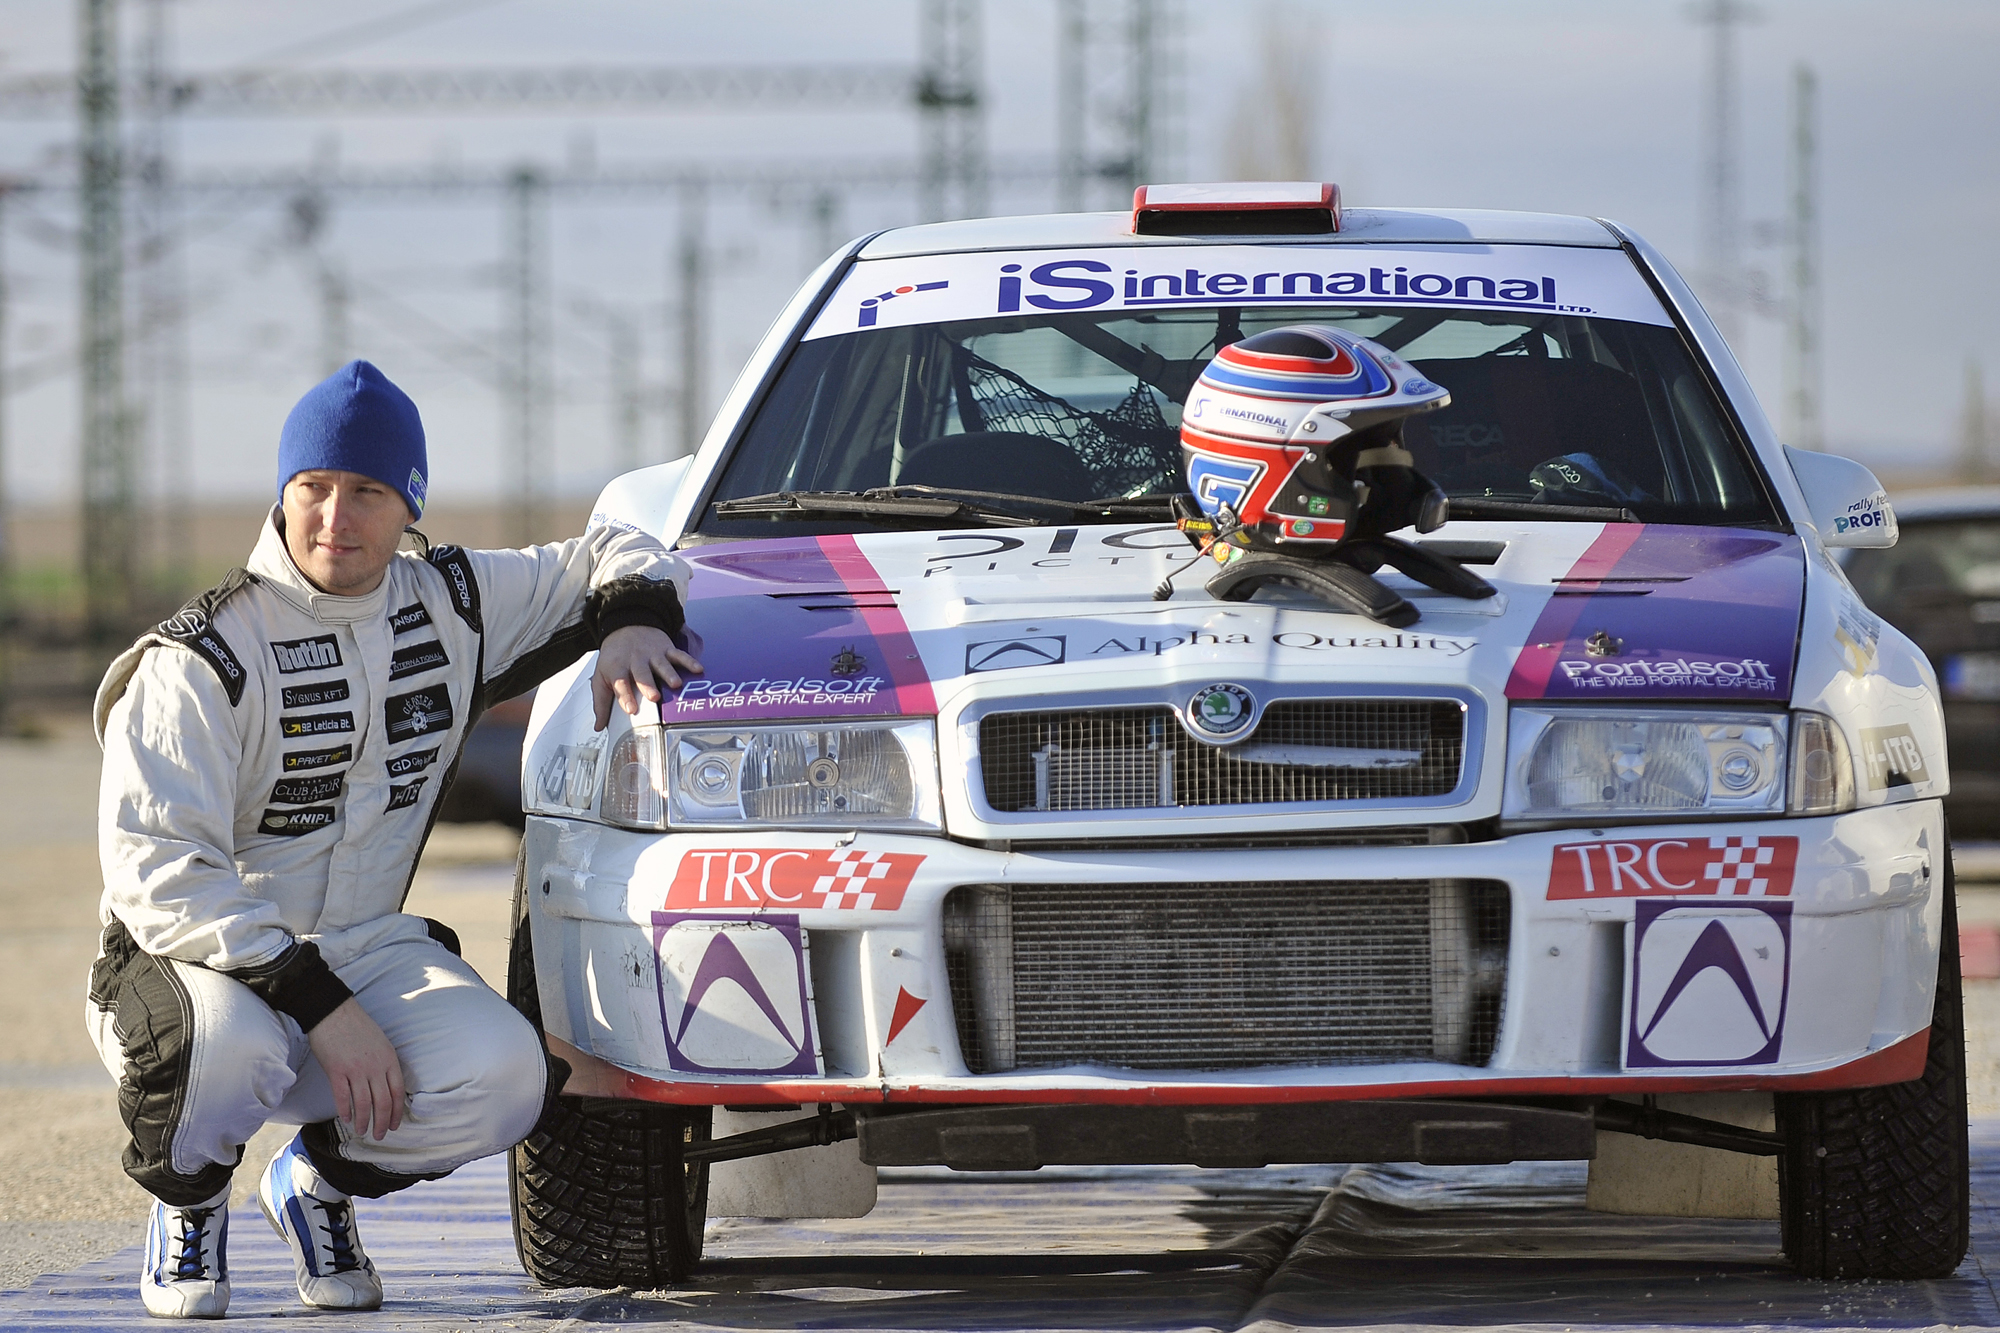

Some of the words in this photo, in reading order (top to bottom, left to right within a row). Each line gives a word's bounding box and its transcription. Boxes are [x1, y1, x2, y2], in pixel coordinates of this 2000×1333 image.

[1123, 266, 1556, 306] international
[1557, 304, 1598, 314] LTD.
[1848, 498, 1873, 513] rally
[1833, 510, 1890, 533] PROFI
[447, 562, 471, 608] sparco
[1093, 629, 1255, 657] Alpha
[1272, 631, 1481, 657] Quality
[199, 636, 240, 679] sparco
[273, 640, 338, 671] Rutin
[1560, 658, 1776, 680] Portalsoft
[677, 677, 884, 701] Portalsoft
[1572, 676, 1605, 688] THE
[1608, 675, 1646, 688] WEB
[1650, 675, 1715, 688] PORTAL
[1717, 676, 1777, 691] EXPERT
[676, 700, 705, 713] THE
[709, 695, 744, 708] WEB
[747, 693, 809, 706] PORTAL
[814, 692, 876, 704] EXPERT
[301, 722, 312, 733] 92
[391, 758, 411, 773] GD
[1863, 735, 1923, 778] H-ITB
[275, 784, 309, 797] CLUB
[289, 813, 332, 824] KNIPL
[691, 851, 810, 902] TRC
[1561, 839, 1696, 892] TRC
